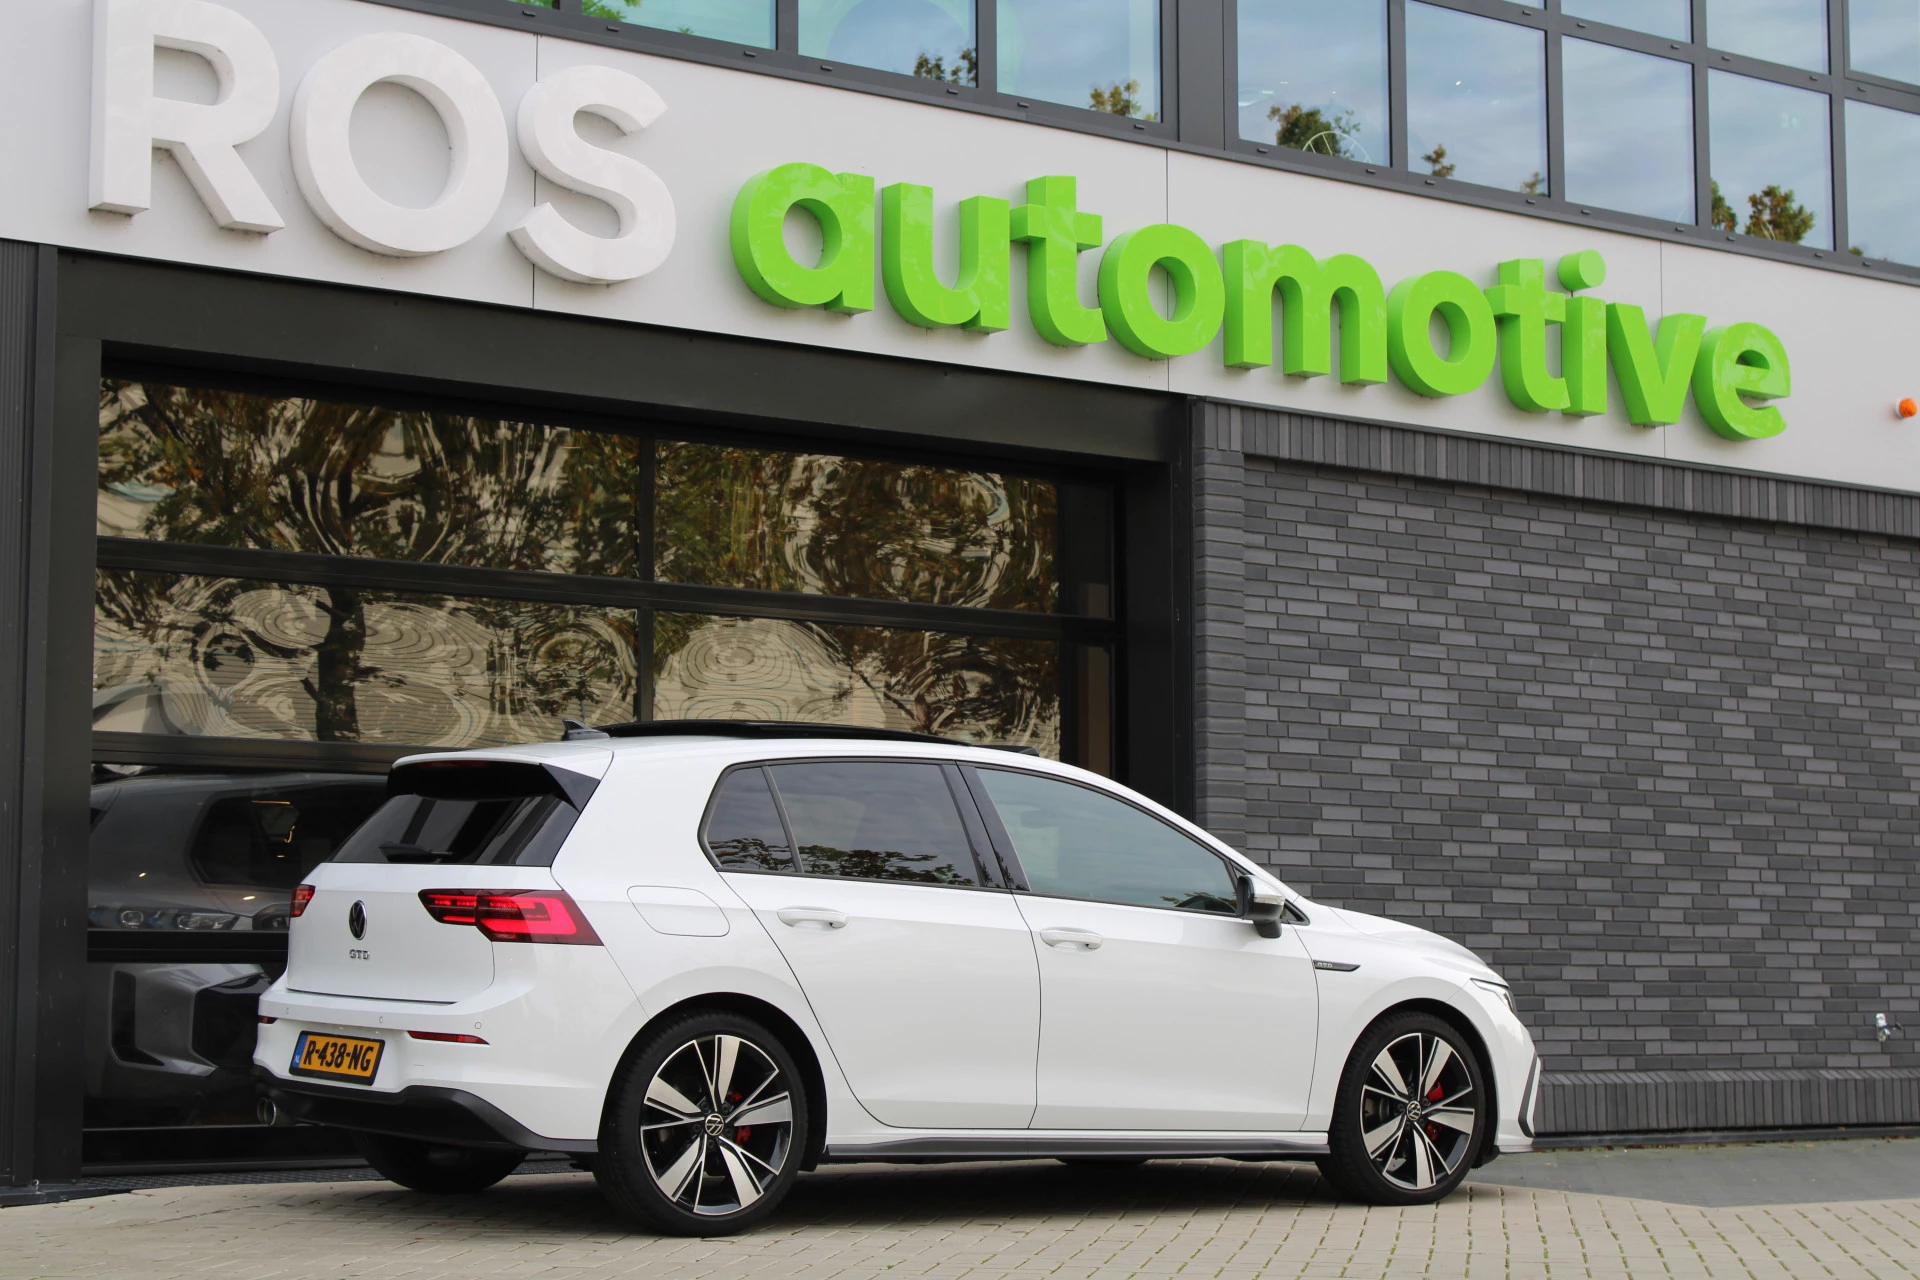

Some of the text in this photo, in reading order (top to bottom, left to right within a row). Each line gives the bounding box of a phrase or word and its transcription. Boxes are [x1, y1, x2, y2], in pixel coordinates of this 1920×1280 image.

[88, 0, 1792, 441] ROS automotive
[349, 948, 370, 960] GTD
[302, 1040, 374, 1072] R-438-NG
